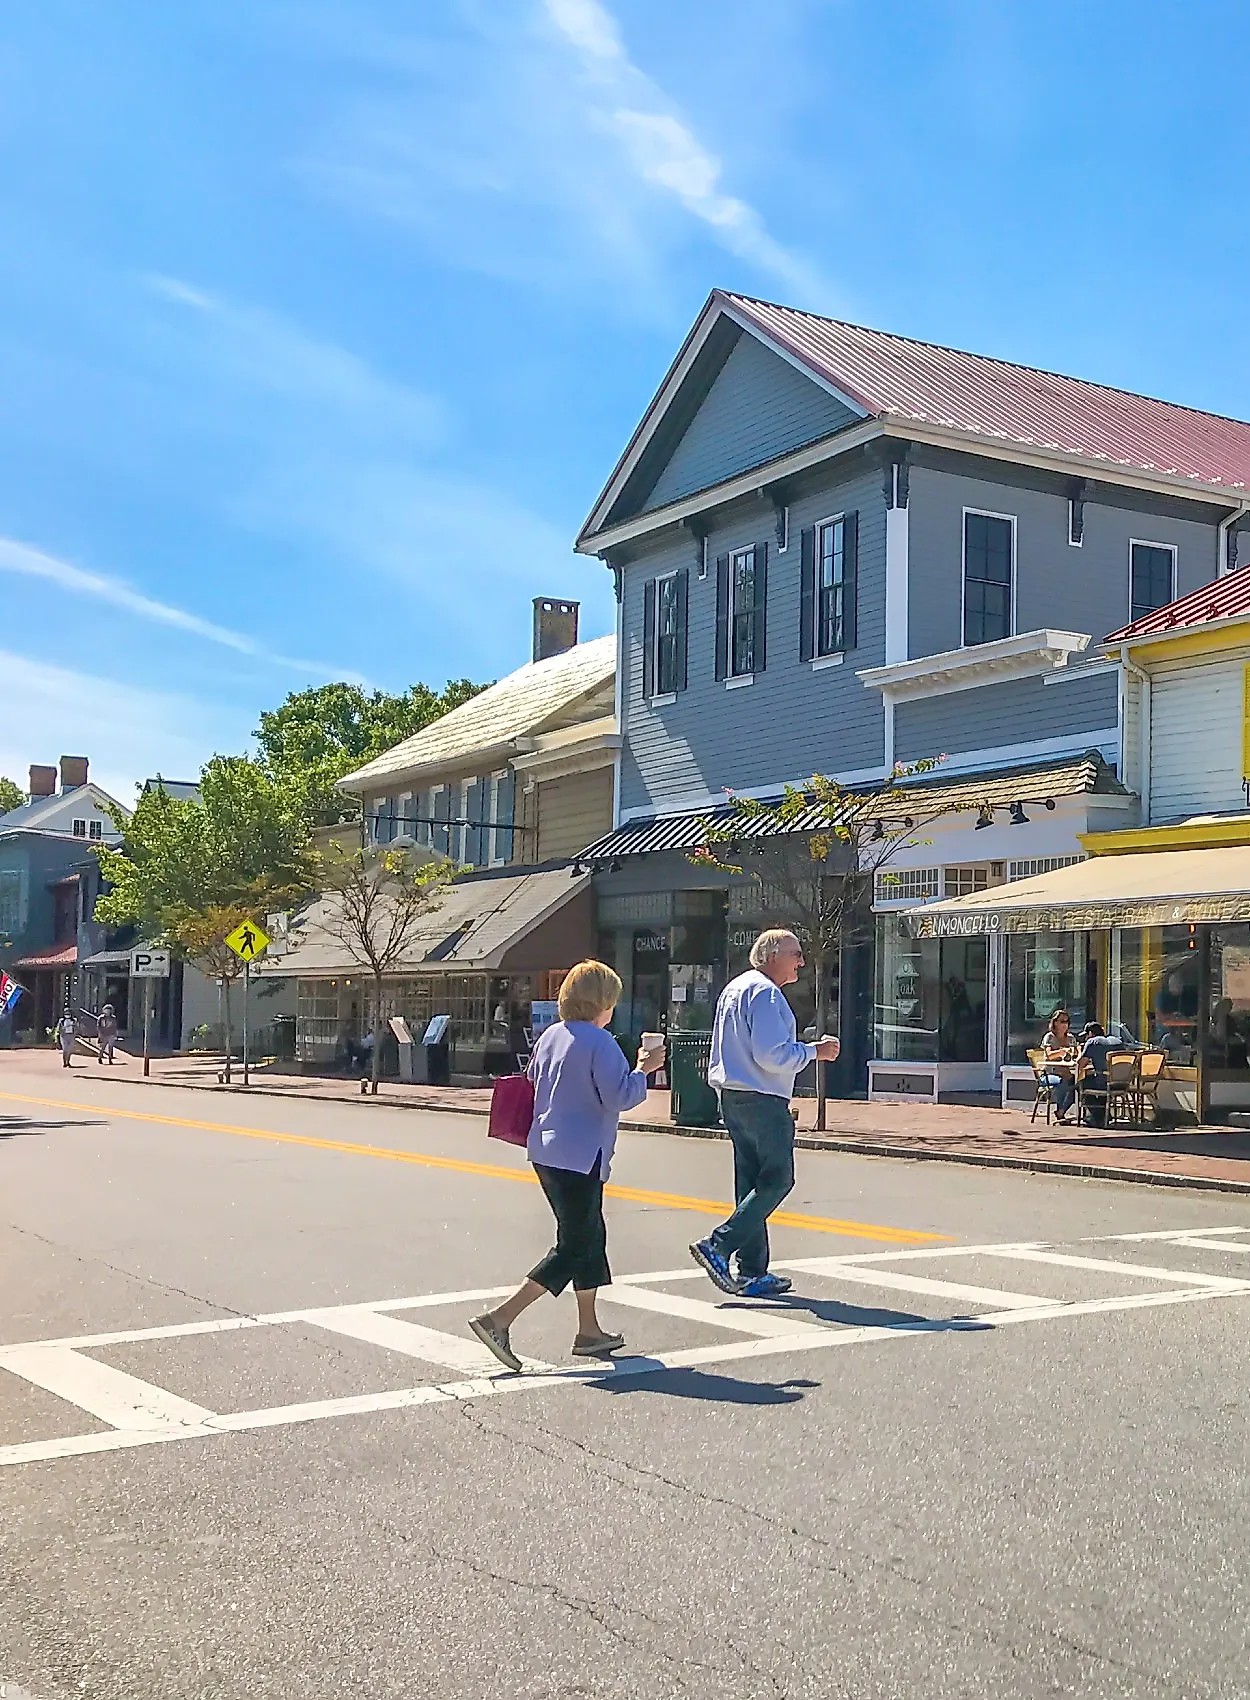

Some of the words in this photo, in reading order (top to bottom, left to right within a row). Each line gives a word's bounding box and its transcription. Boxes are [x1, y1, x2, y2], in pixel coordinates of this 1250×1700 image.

[931, 914, 1000, 936] LIMONCELLO
[1171, 906, 1181, 918] &
[635, 936, 666, 951] CHANCE
